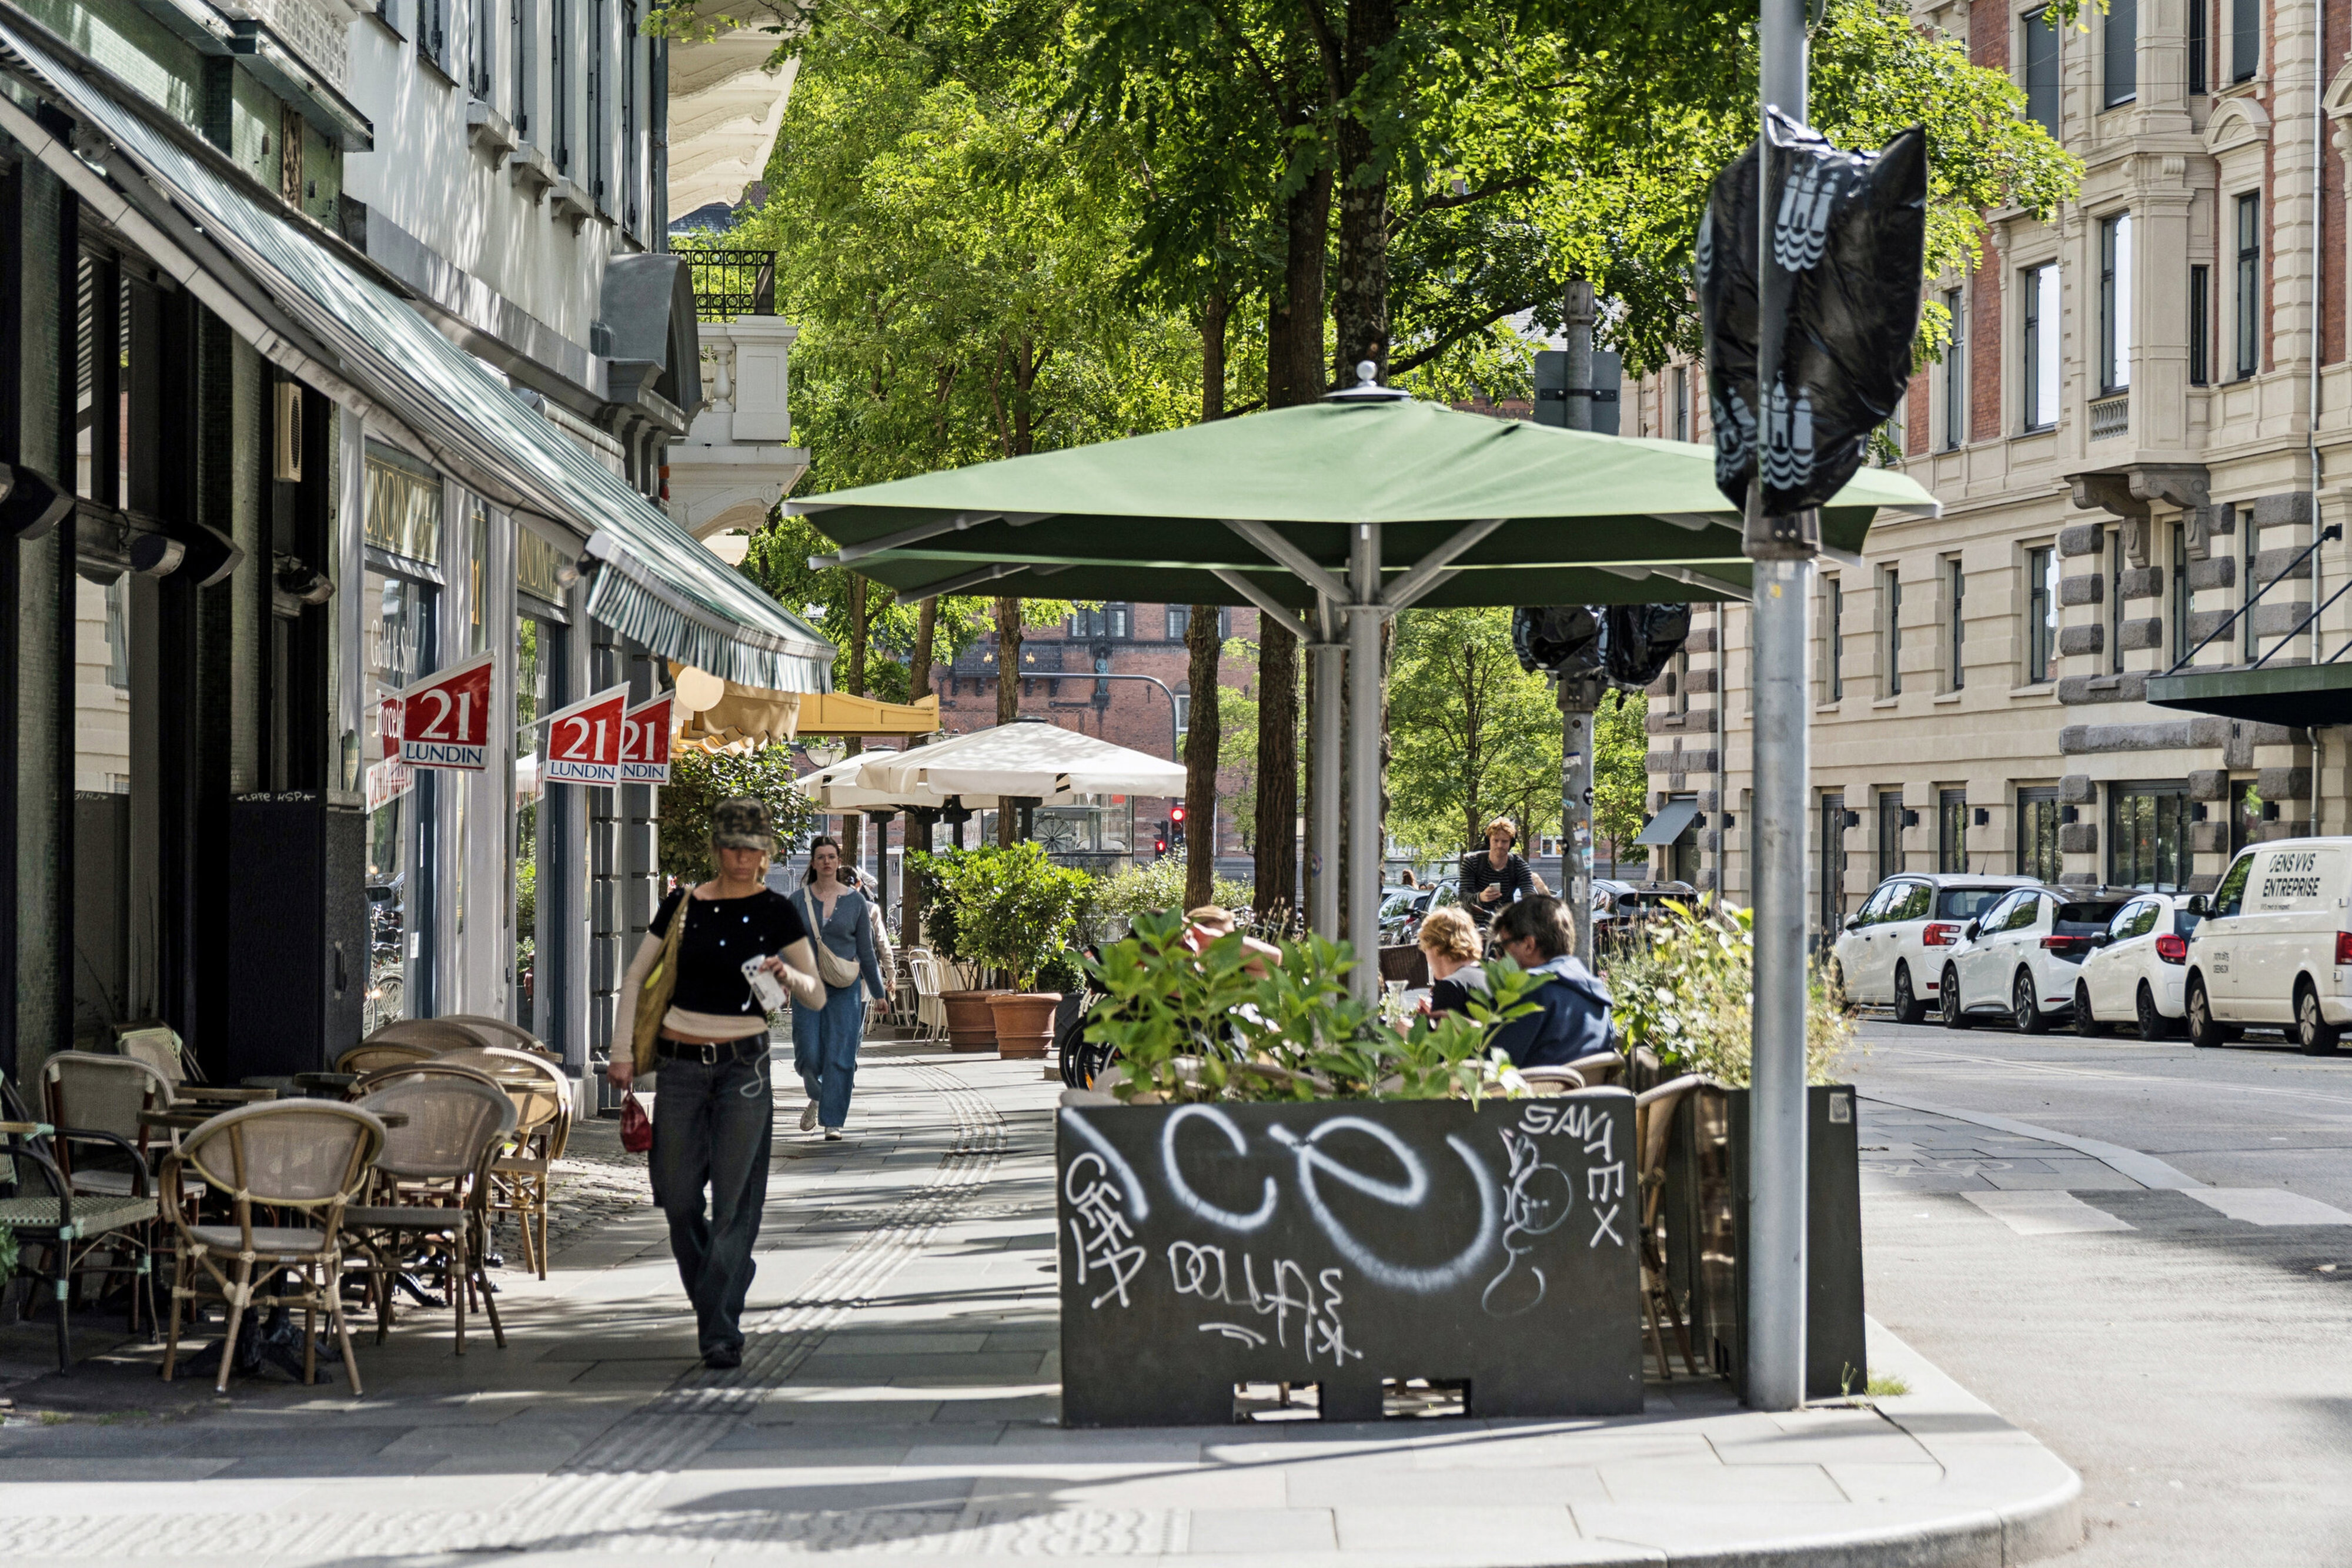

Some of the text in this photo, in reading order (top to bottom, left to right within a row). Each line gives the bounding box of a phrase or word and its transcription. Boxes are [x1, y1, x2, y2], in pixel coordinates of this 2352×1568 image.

[364, 463, 411, 546] UNDIN
[370, 619, 391, 669] Guld
[392, 626, 399, 671] &
[419, 688, 470, 741] 21
[2233, 723, 2240, 739] 14
[406, 743, 482, 764] LUNDIN
[562, 716, 607, 761] 21
[622, 720, 656, 761] 21
[369, 765, 389, 808] GULD
[550, 761, 616, 780] LUNDIN
[2296, 852, 2316, 872] VVS
[2263, 877, 2320, 897] ENTREPRISE
